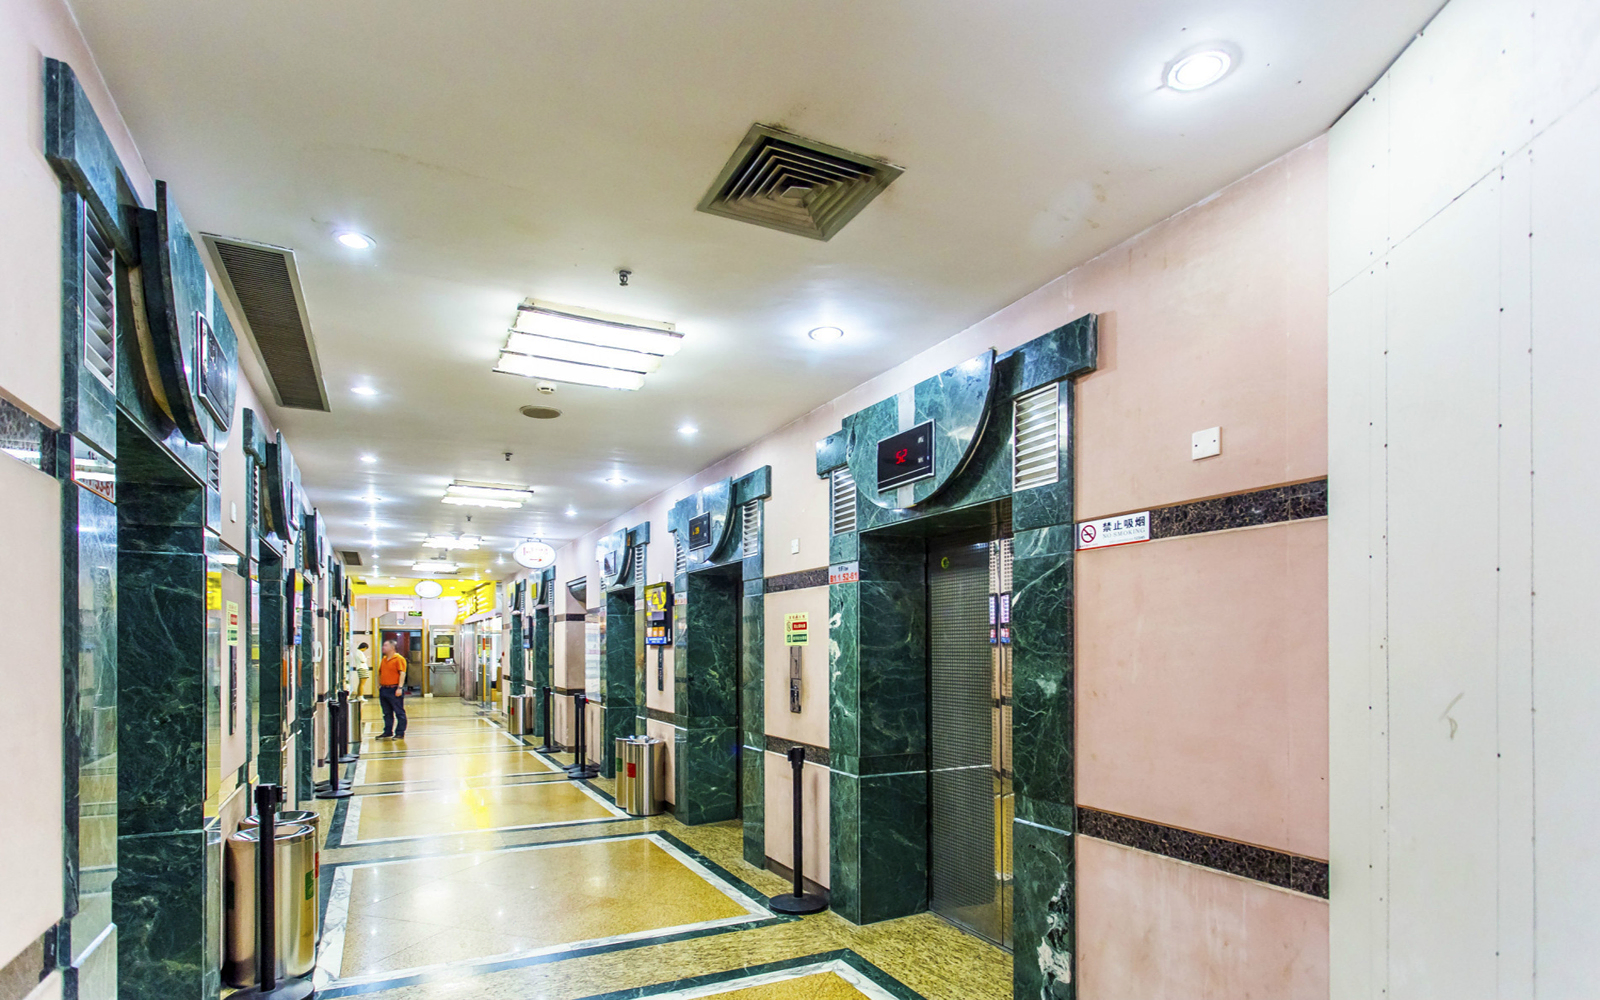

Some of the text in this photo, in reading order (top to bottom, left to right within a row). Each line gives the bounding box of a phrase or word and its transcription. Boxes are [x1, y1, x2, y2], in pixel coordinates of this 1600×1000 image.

[895, 448, 908, 465] 52
[1103, 516, 1145, 532] 禁止吸烟
[1113, 528, 1146, 537] SMOKING
